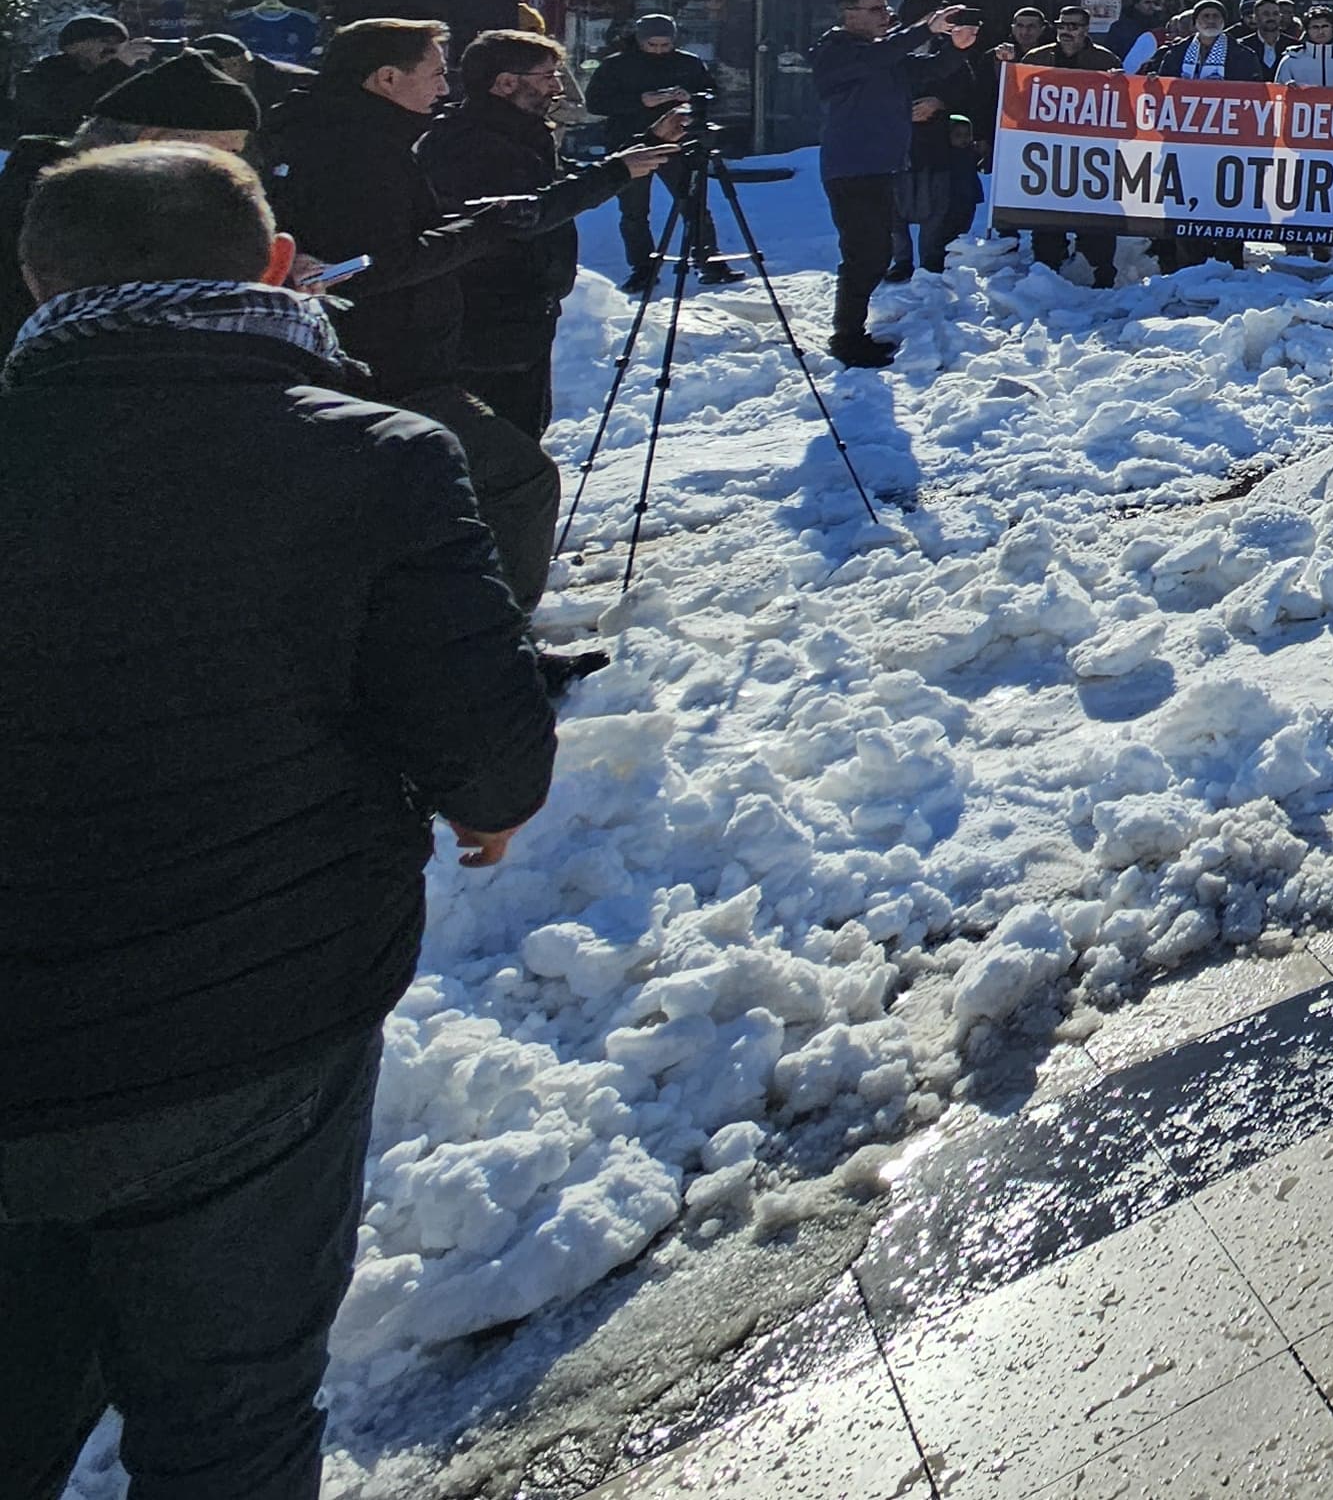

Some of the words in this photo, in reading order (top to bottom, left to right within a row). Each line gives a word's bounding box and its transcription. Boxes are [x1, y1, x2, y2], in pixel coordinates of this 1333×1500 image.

[1029, 77, 1128, 129] İSRAİL
[1020, 141, 1199, 213] SUSMA,
[1176, 222, 1274, 241] DİYARBAKIR
[1279, 225, 1333, 244] İSLAMİ
